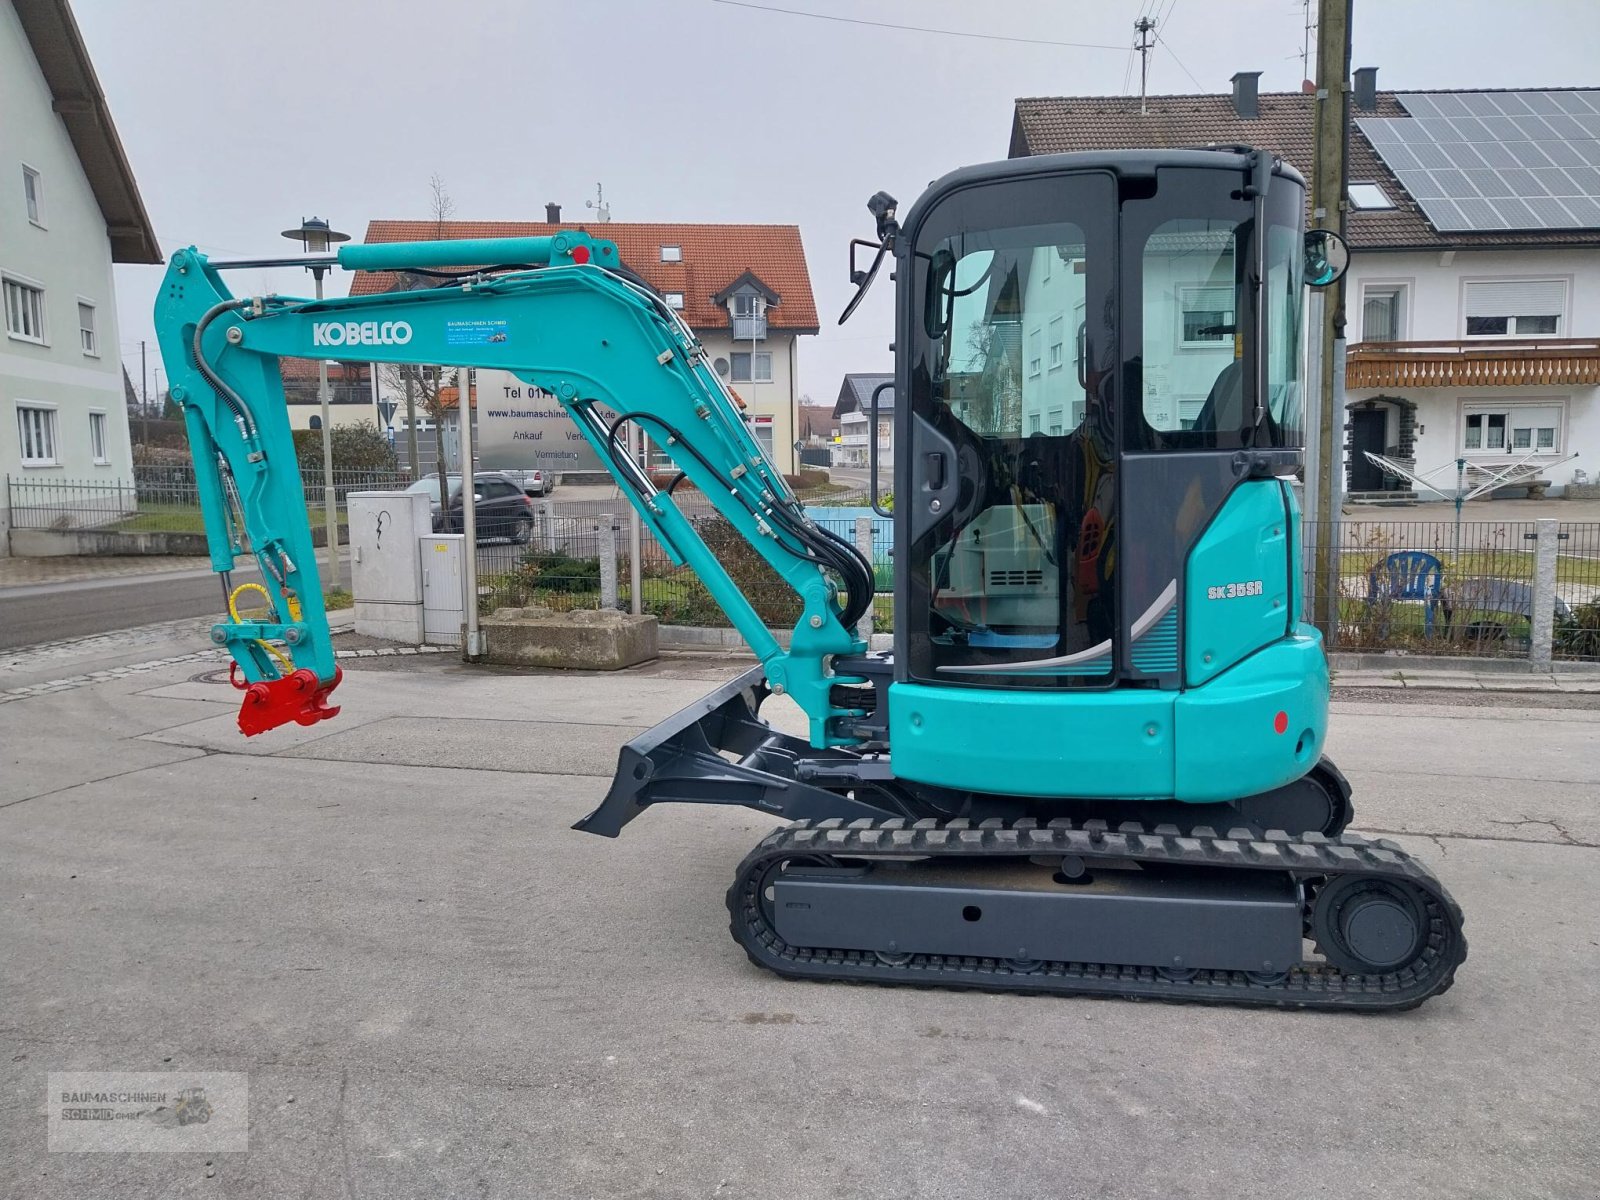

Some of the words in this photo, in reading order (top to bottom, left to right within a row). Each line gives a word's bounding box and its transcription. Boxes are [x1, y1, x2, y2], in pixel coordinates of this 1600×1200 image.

[313, 321, 413, 346] KOBELCO
[503, 387, 521, 399] Tel
[513, 431, 543, 441] Ankauf
[565, 431, 588, 441] Verk
[535, 449, 579, 460] Vermietung
